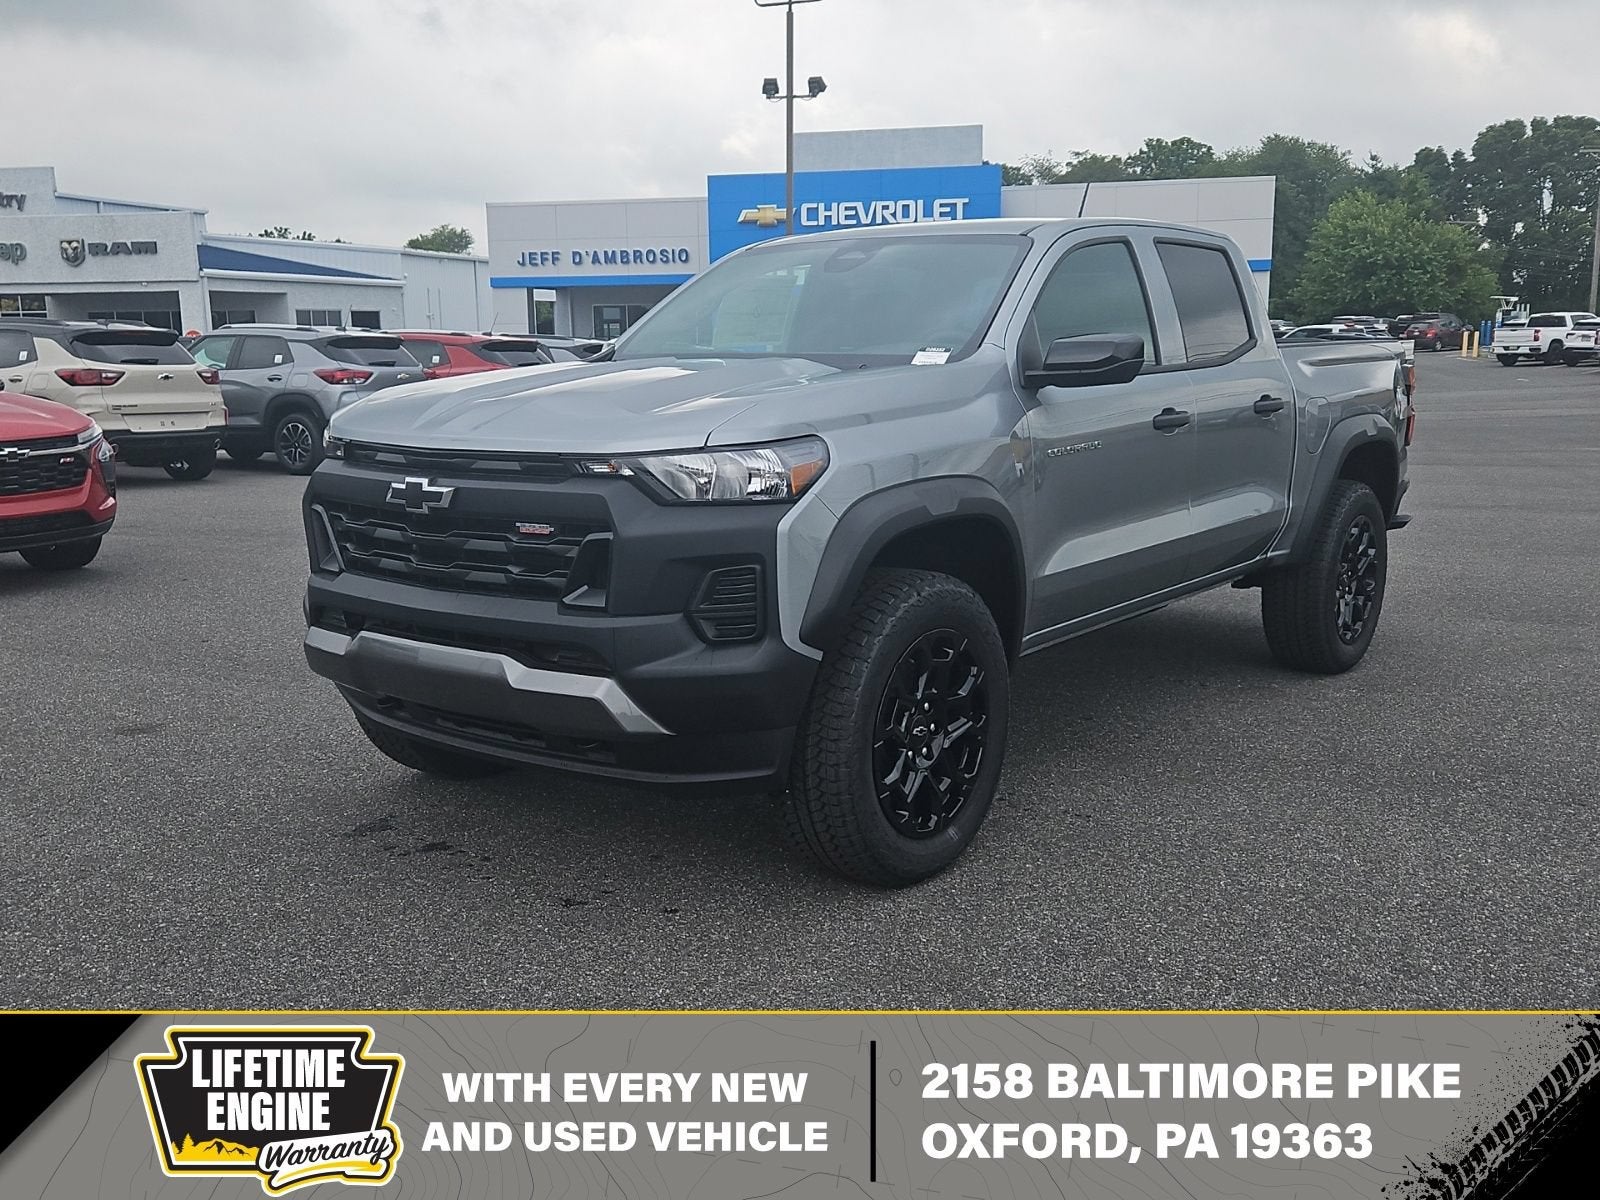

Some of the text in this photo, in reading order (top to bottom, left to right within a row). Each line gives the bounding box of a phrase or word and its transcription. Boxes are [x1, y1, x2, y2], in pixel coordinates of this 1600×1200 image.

[801, 198, 969, 226] CHEVROLET
[87, 240, 158, 257] RAM
[517, 248, 690, 267] JEFF D'AMBROSIO
